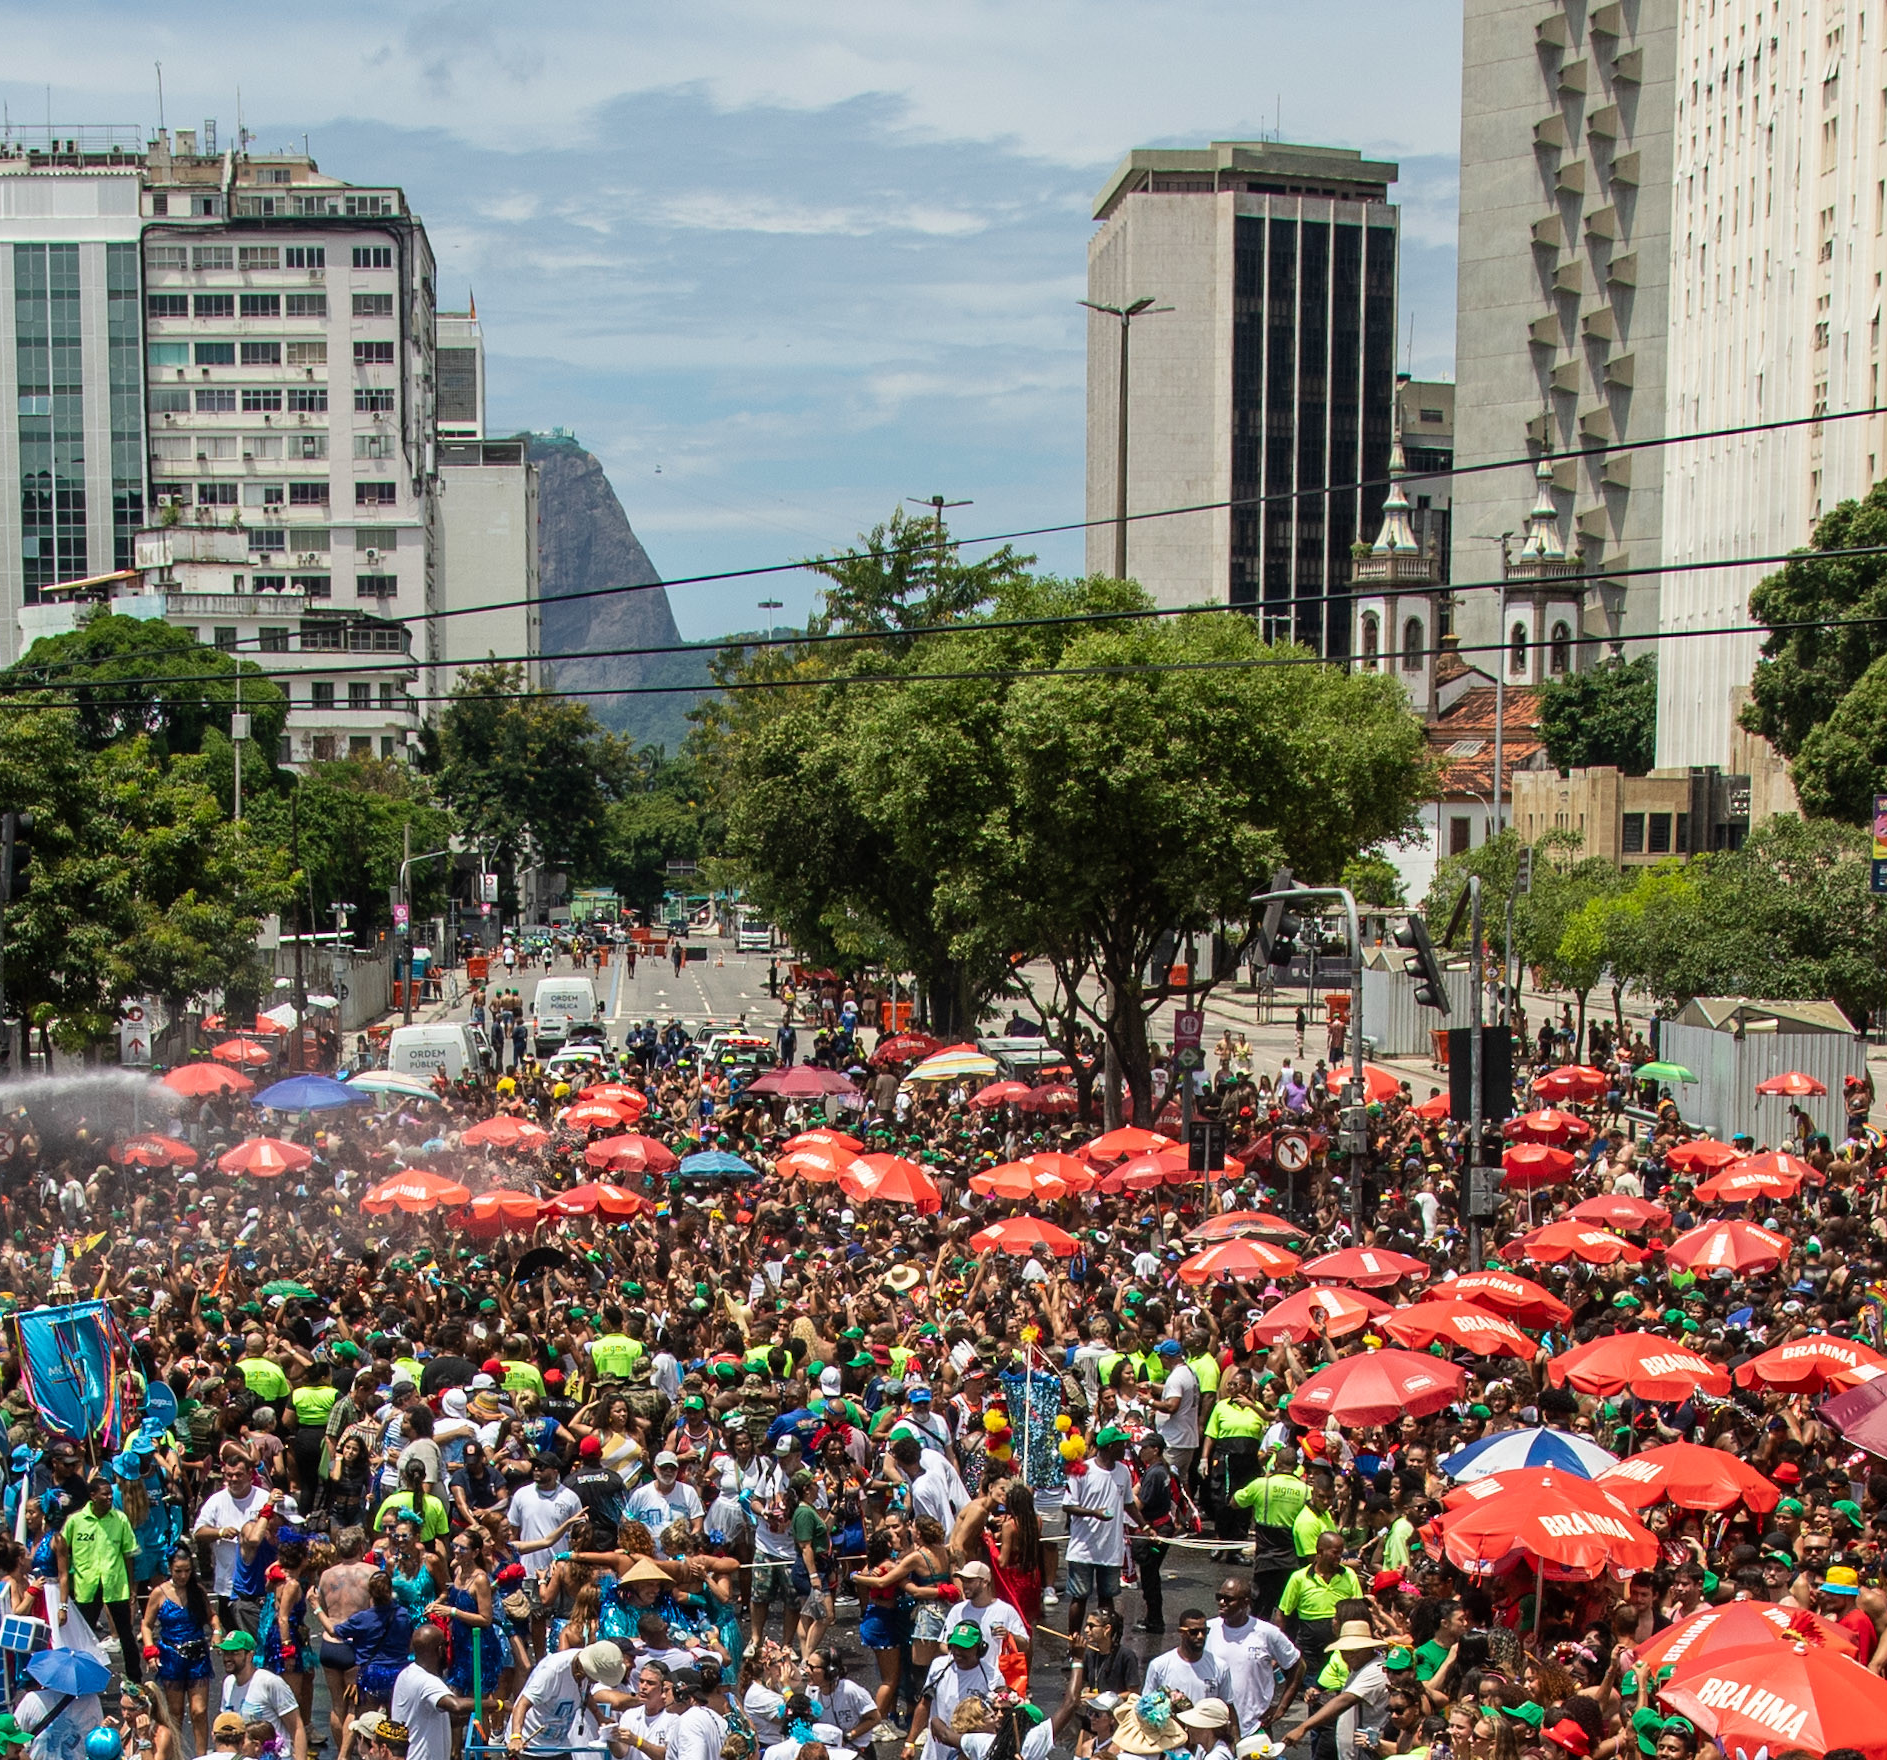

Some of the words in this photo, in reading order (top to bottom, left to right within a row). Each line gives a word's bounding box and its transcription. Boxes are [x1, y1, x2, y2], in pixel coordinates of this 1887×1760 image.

[551, 994, 578, 1002] ORDEM
[551, 1001, 578, 1010] PÚBLICA
[410, 1050, 446, 1058] ORDEM
[1731, 1172, 1782, 1189] BRAHMA
[1456, 1276, 1525, 1297] BRAHMA
[1452, 1314, 1525, 1342] BRAHMA
[603, 1345, 627, 1355] sigma
[1781, 1344, 1858, 1367] BRAHMA
[1639, 1353, 1715, 1381] BRAHMA
[1272, 1484, 1302, 1499] sigma
[77, 1532, 94, 1542] 224
[1538, 1516, 1636, 1542] BRAHMA
[1663, 1614, 1722, 1662] BRAHMA
[1695, 1677, 1810, 1741] BRAHMA
